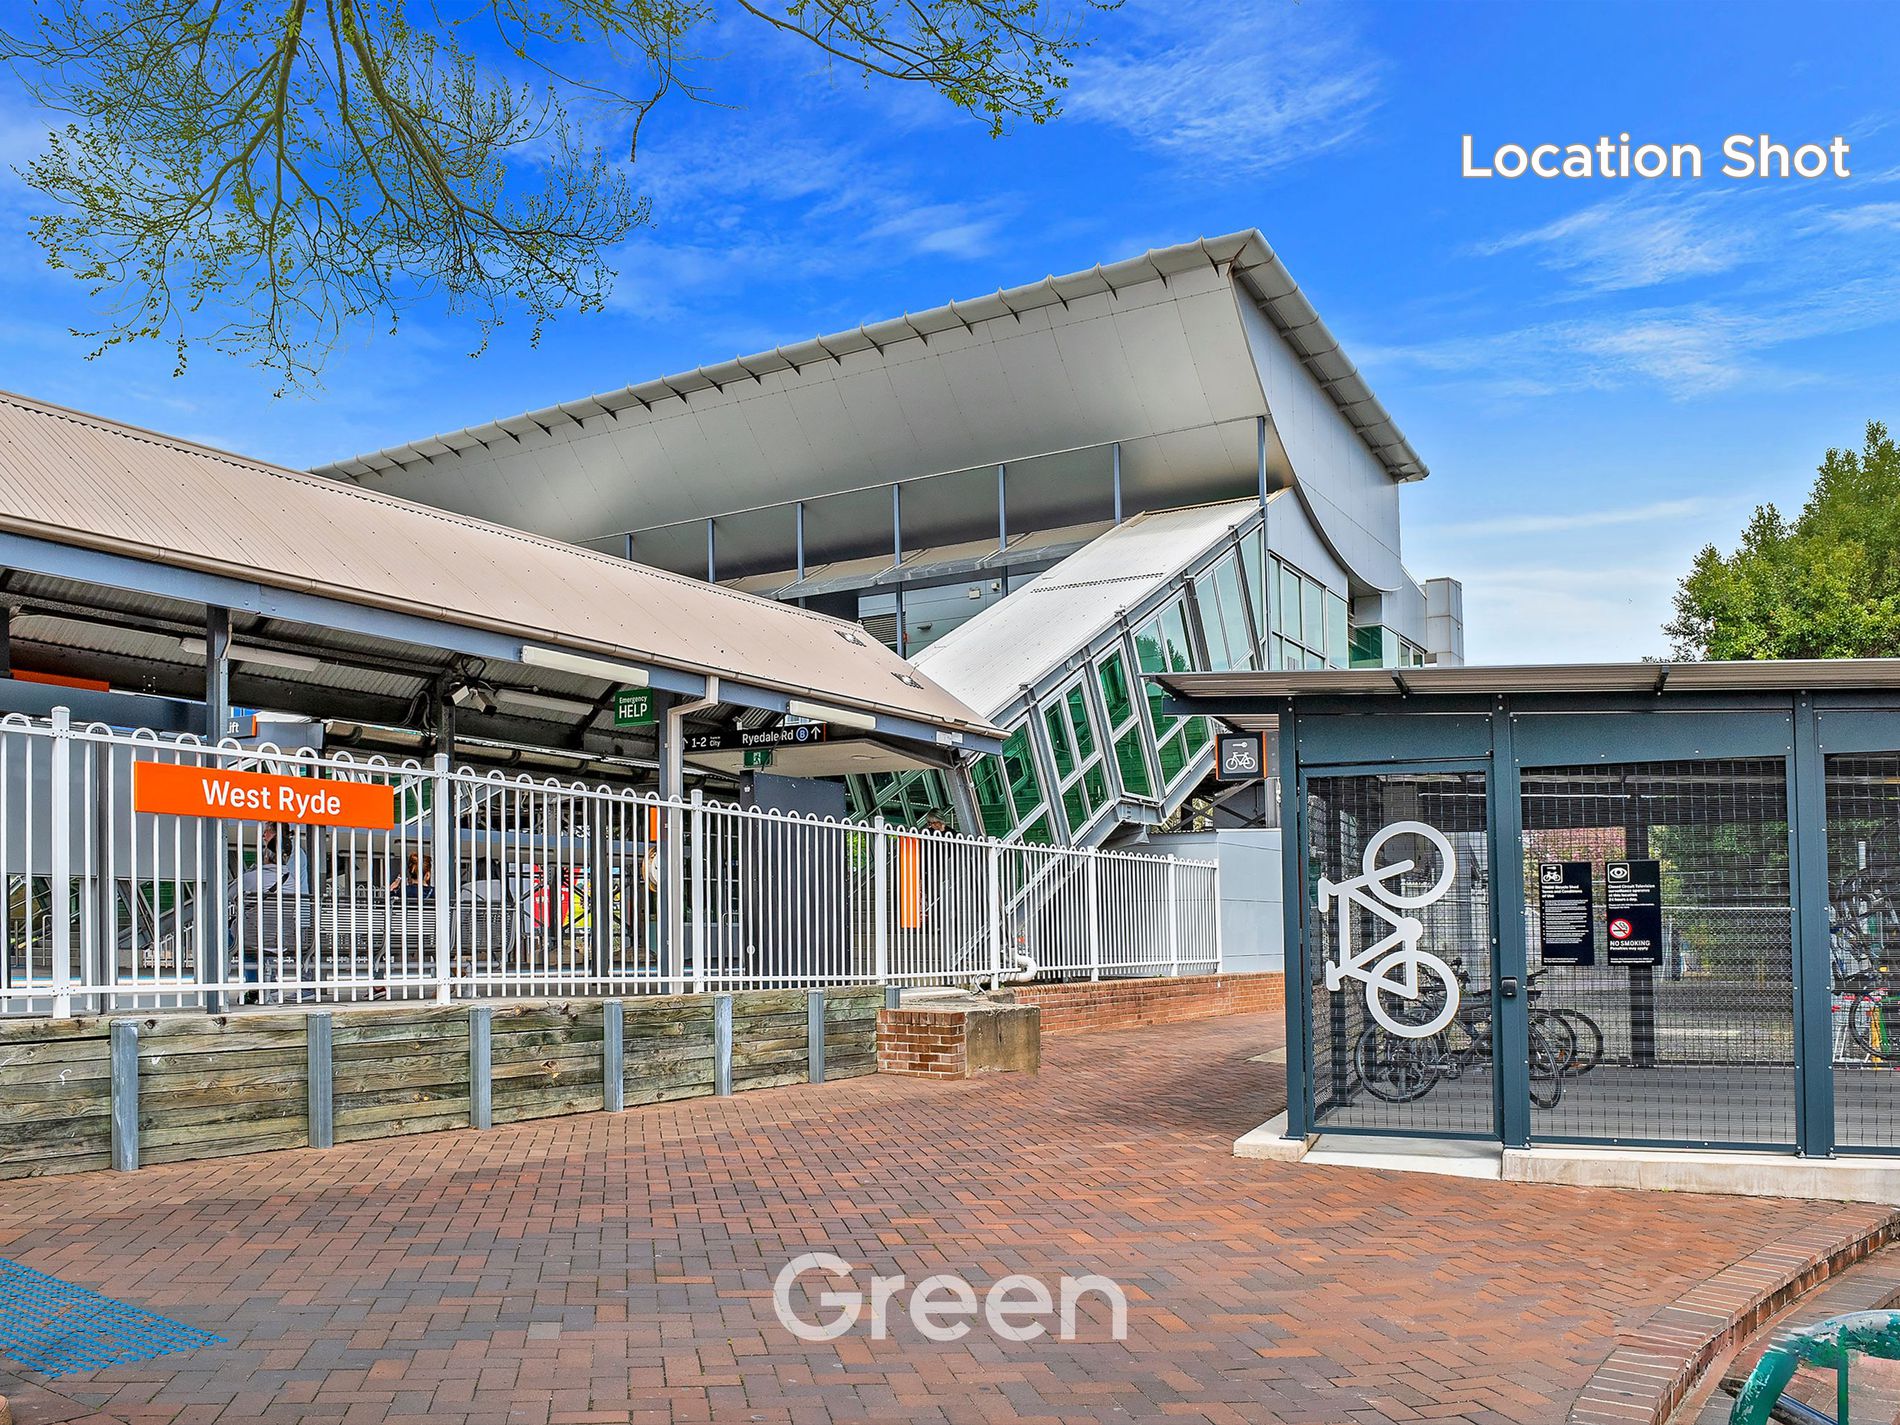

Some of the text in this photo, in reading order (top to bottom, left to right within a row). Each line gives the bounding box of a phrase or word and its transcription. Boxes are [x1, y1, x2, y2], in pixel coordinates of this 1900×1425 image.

[619, 696, 647, 704] Emergency
[619, 703, 648, 719] HELP
[227, 721, 239, 734] ift
[691, 736, 707, 748] 1-2
[742, 731, 779, 746] Ryedale
[781, 730, 794, 741] Rd
[202, 779, 341, 818] West Ryde
